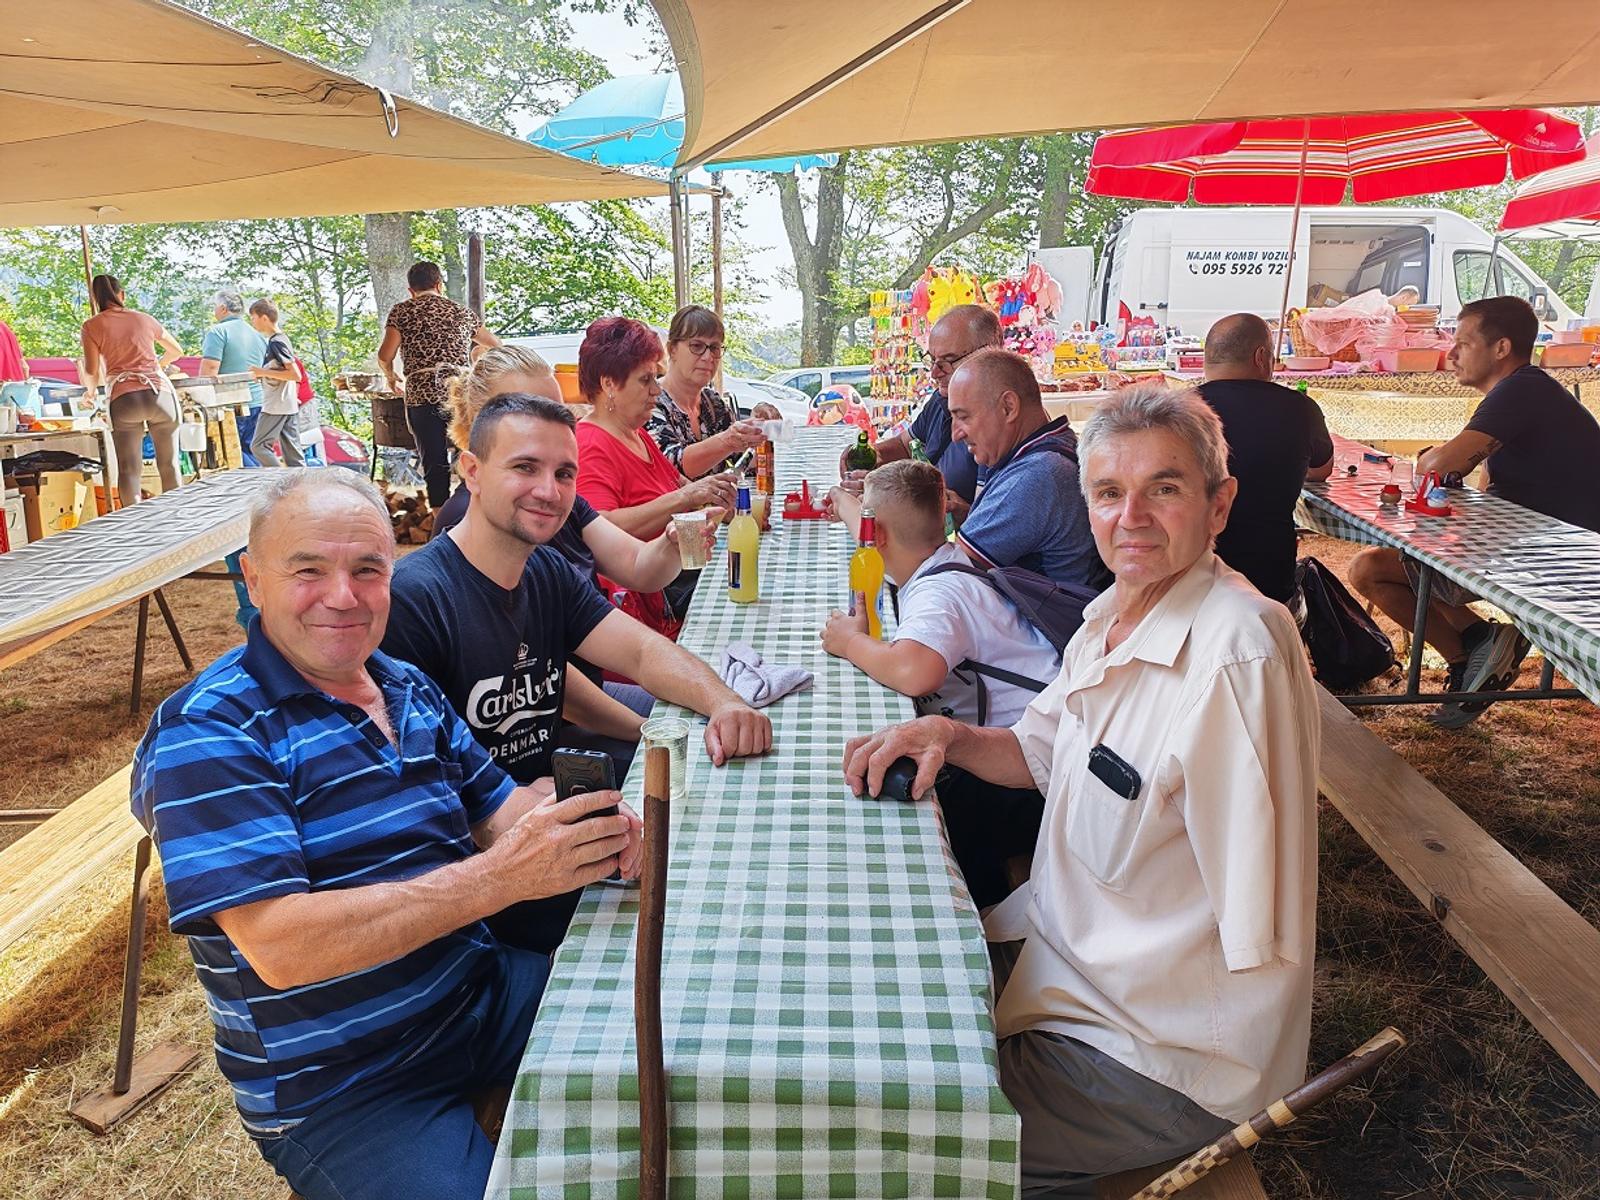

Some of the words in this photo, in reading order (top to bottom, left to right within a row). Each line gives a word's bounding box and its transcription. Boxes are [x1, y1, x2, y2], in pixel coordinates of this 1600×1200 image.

[1186, 251, 1221, 261] NAJAM
[1225, 251, 1258, 261] KOMBI
[1202, 263, 1226, 275] 095
[1230, 263, 1263, 275] 5926
[466, 667, 562, 729] Carlsbr
[489, 725, 553, 758] DENMAR
